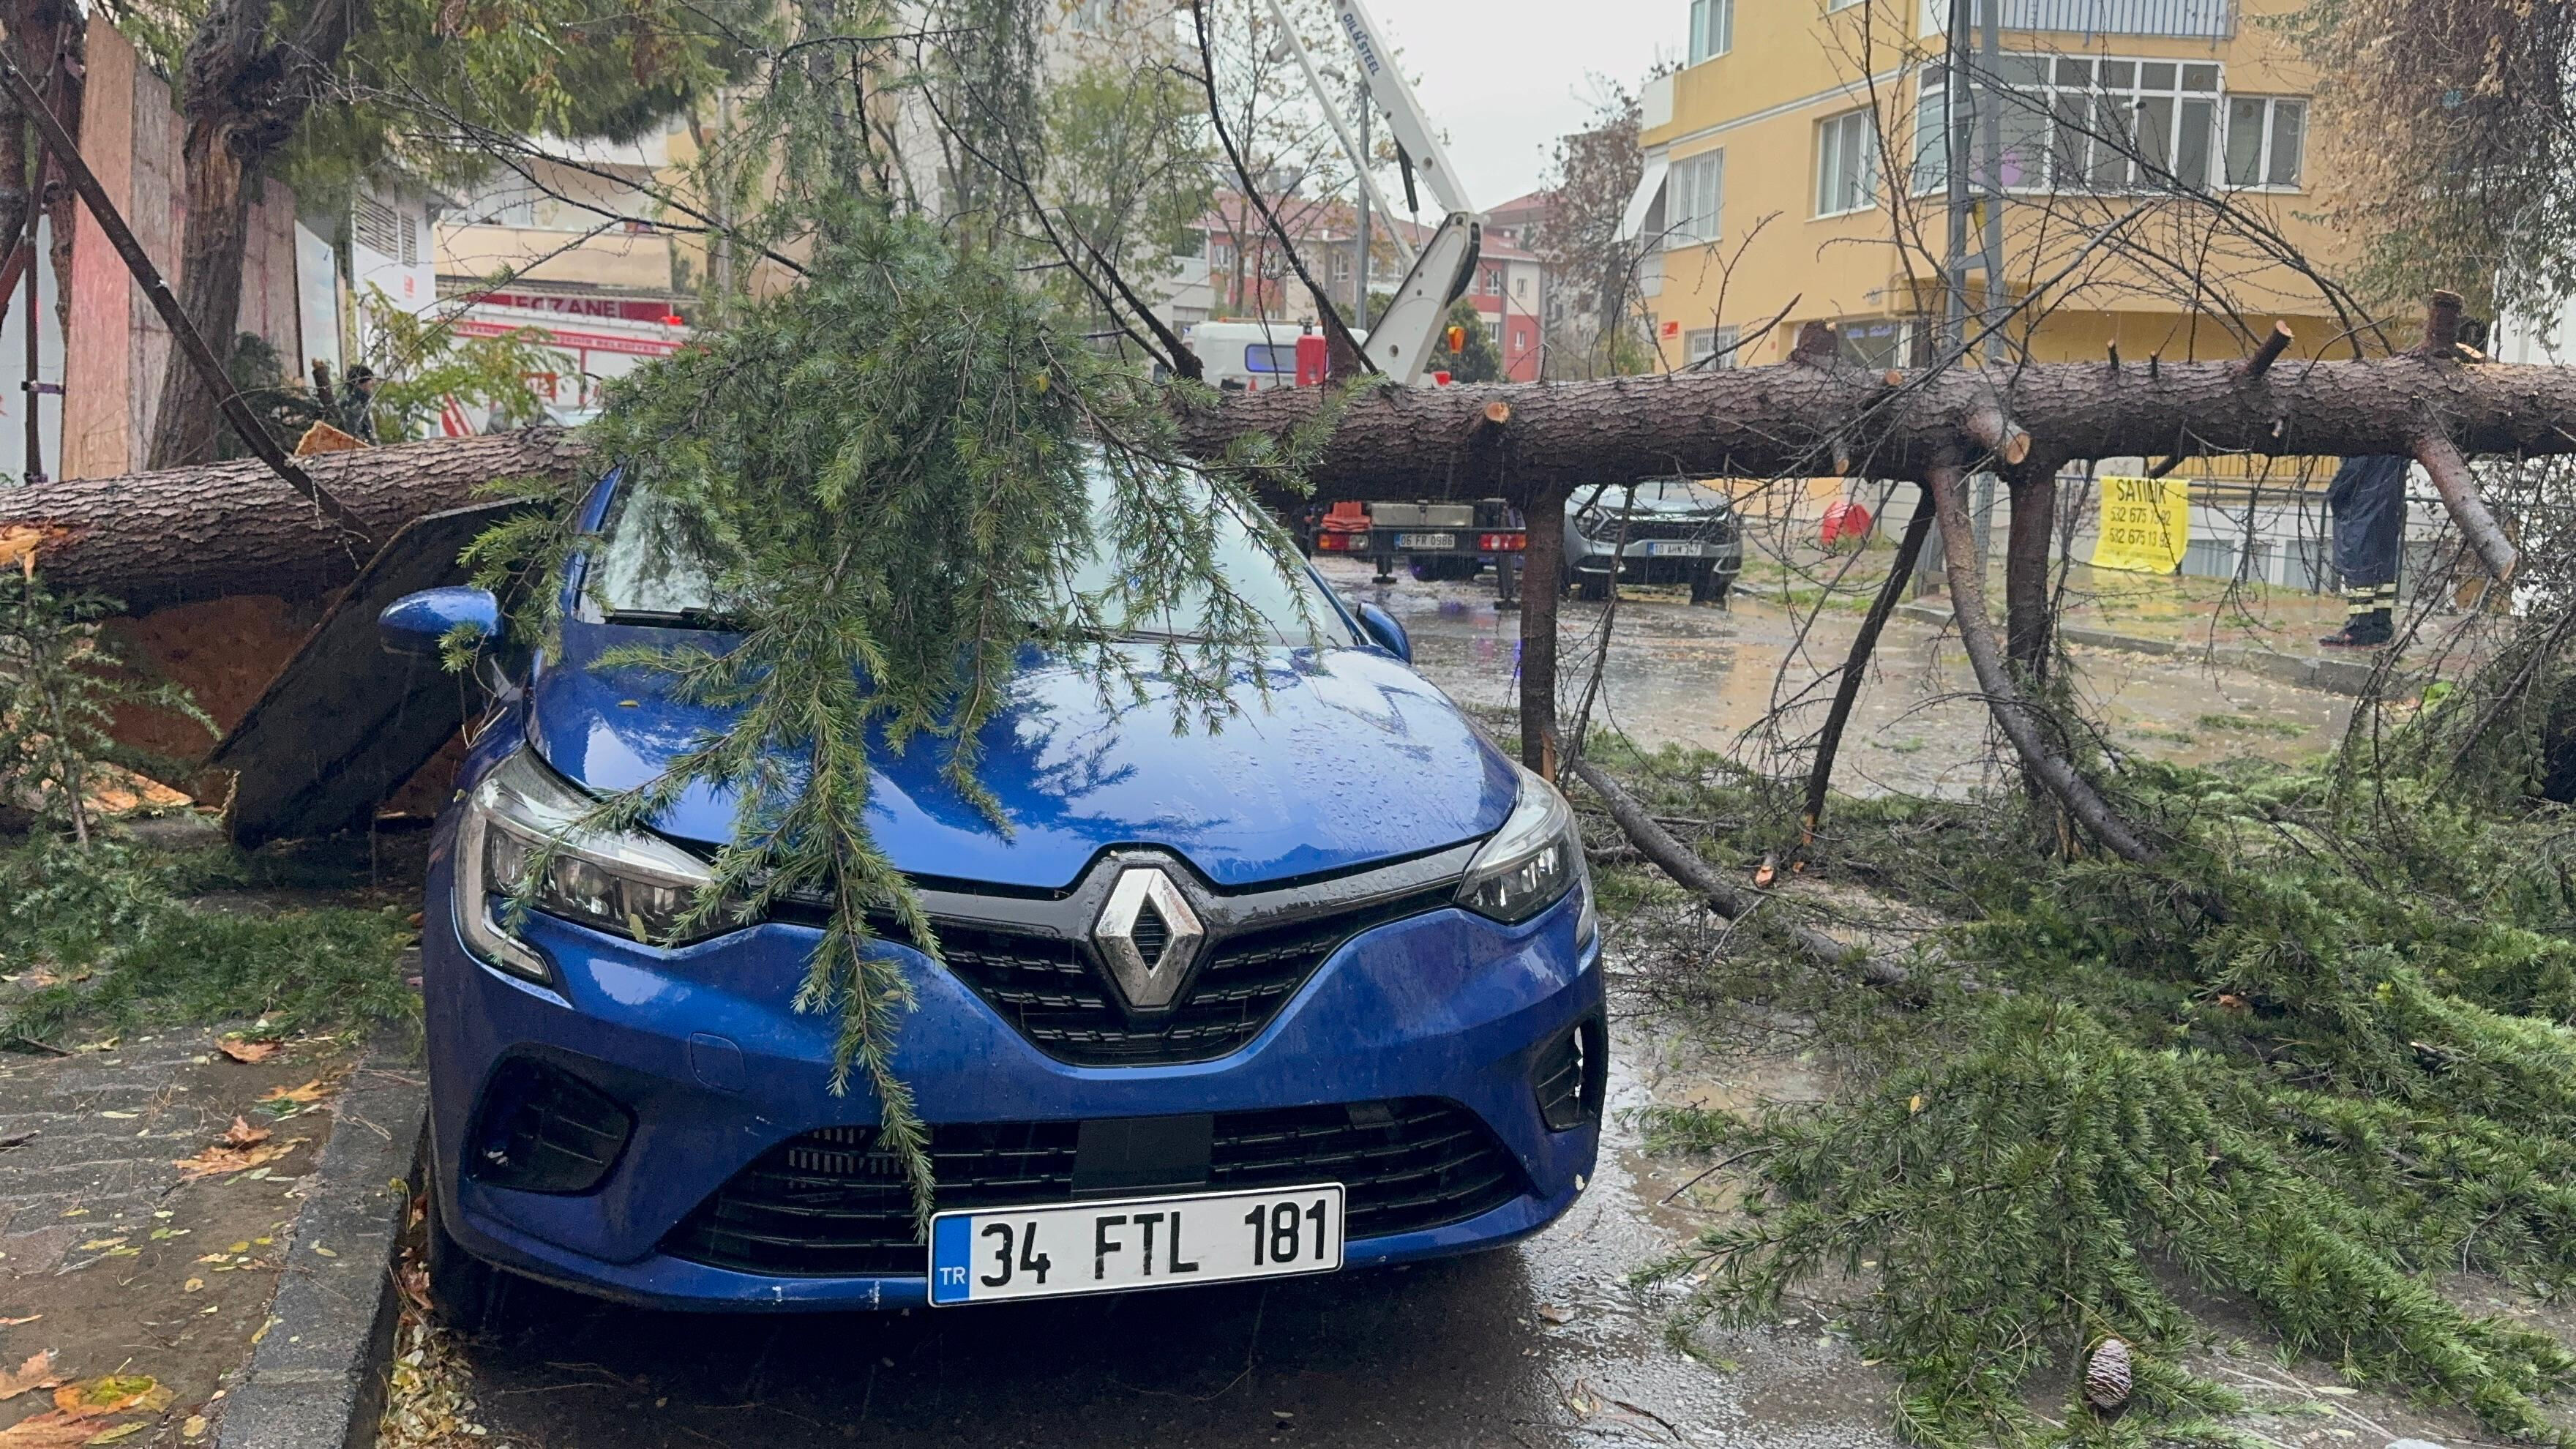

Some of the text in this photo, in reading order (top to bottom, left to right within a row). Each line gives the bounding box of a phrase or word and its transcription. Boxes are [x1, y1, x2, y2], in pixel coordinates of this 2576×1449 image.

[2116, 479, 2166, 504] SATILIK
[2110, 506, 2126, 523] 532
[2130, 507, 2147, 524] 675
[1401, 535, 1412, 546] 06
[1416, 535, 1427, 546] FR
[2109, 528, 2126, 544] 532
[2128, 528, 2146, 545] 675
[940, 1199, 1326, 1287] TR 34 FTL 181
